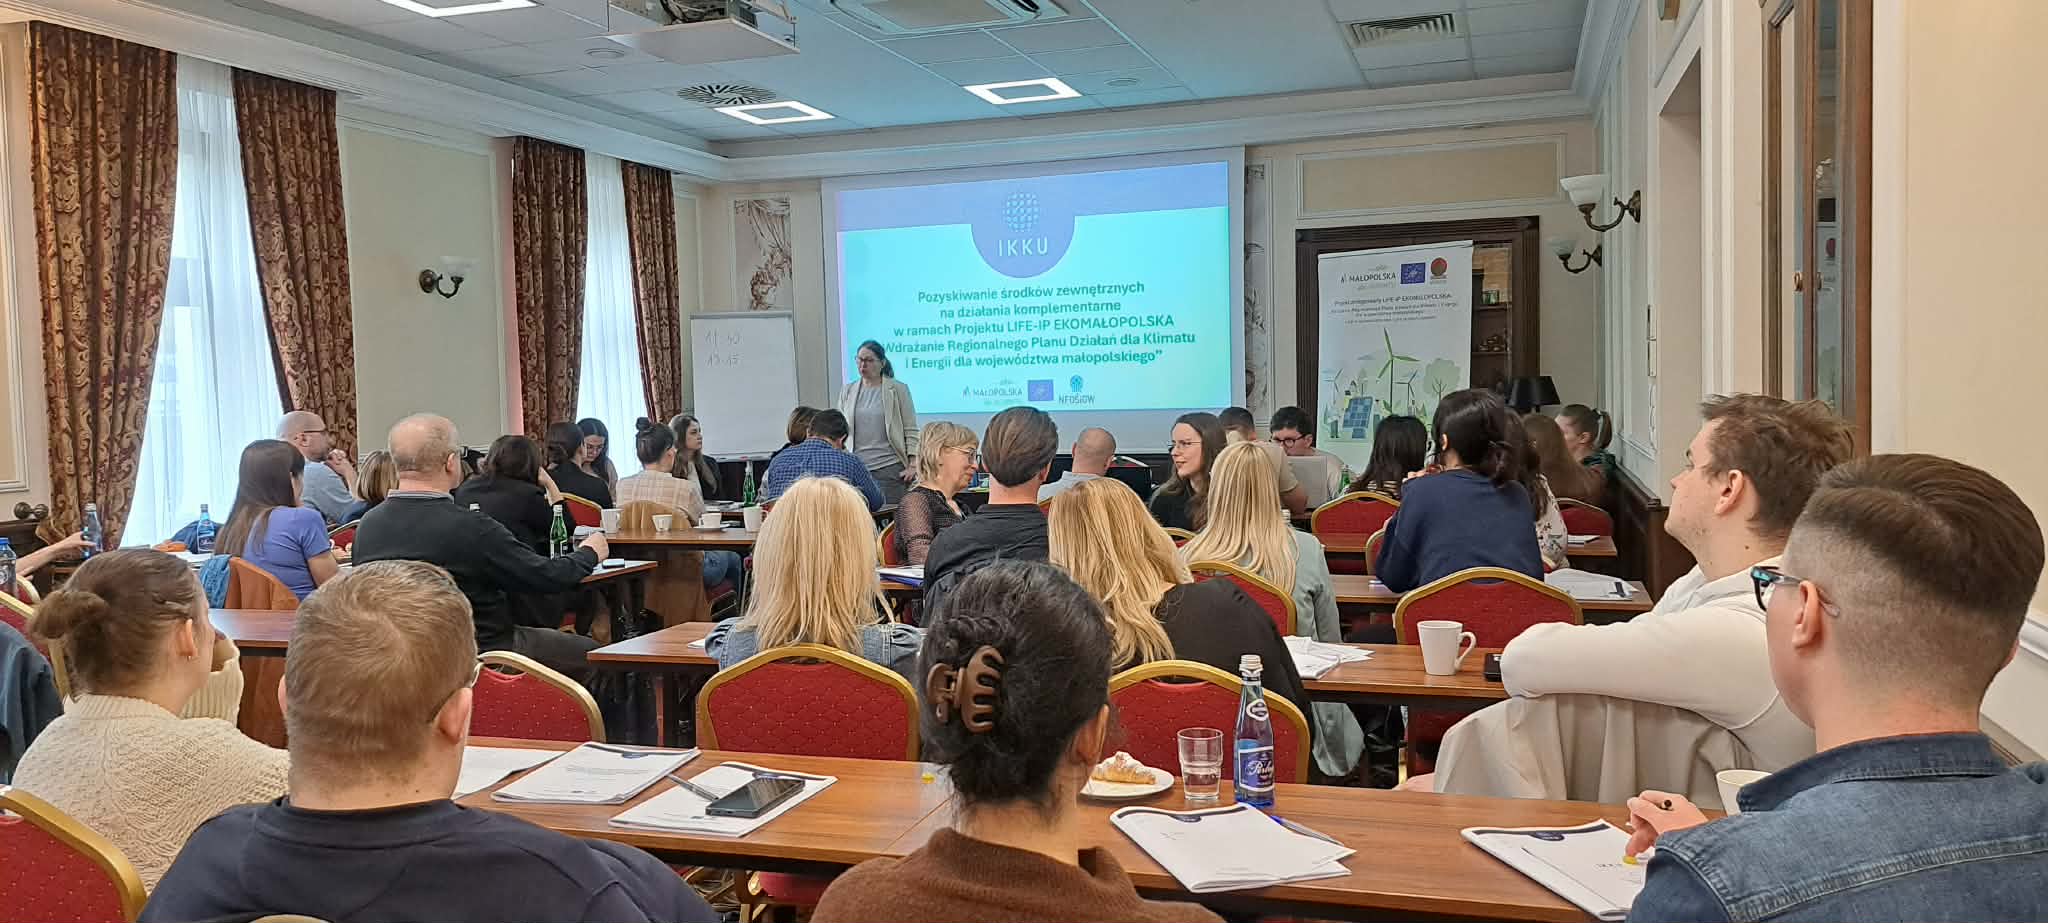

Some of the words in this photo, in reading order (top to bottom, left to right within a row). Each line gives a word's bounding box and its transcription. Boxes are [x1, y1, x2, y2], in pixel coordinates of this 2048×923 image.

[999, 237, 1048, 257] IKKU
[918, 288, 998, 304] Pozyskiwanie
[1001, 285, 1053, 299] środków
[1056, 281, 1145, 297] zewnętrznych
[940, 309, 955, 319] na
[957, 304, 1011, 318] działania
[1014, 301, 1121, 317] komplementarne
[893, 327, 905, 337] w
[906, 324, 951, 336] ramach
[954, 322, 1004, 336] Projektu
[1007, 319, 1051, 332] LIFE-IP
[1054, 315, 1175, 330] EKOMAŁOPOLSKA
[947, 338, 1029, 353] Regionalnego
[1031, 336, 1066, 348] Planu
[1070, 333, 1117, 347] Działań
[1120, 333, 1140, 345] dla
[1143, 331, 1196, 344] Klimatu
[911, 355, 951, 370] Energii
[954, 356, 972, 367] dla
[975, 353, 1059, 368] województwa
